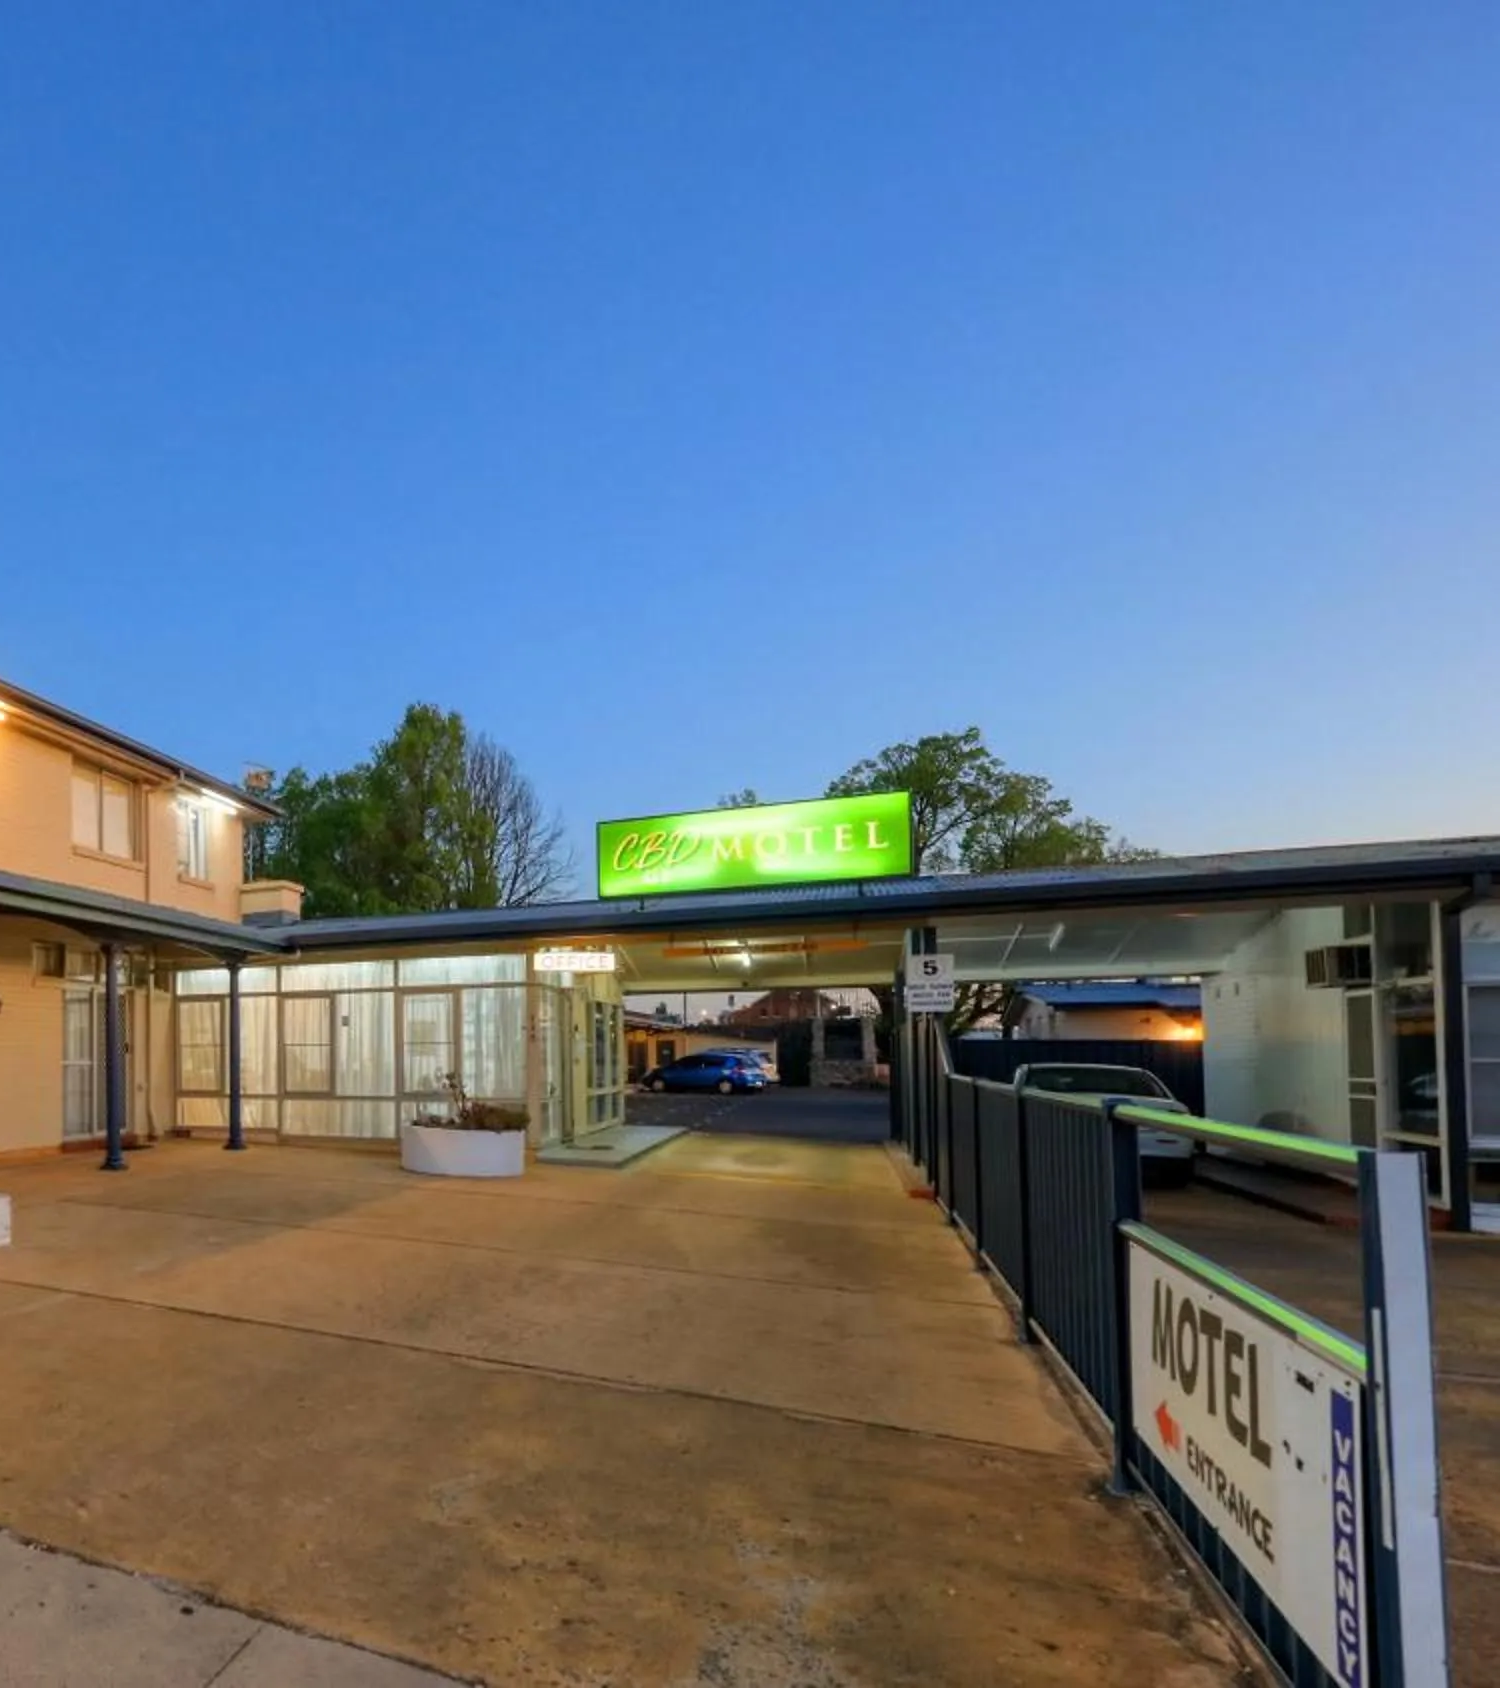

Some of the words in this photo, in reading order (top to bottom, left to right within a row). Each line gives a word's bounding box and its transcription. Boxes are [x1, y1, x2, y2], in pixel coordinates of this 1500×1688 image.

[612, 831, 701, 872] CBD
[711, 820, 889, 862] MOTEL
[542, 955, 609, 969] OFFICE
[923, 960, 938, 976] 5
[1151, 1278, 1272, 1470] MOTEL
[1186, 1436, 1275, 1565] ENTRANCE
[1334, 1429, 1358, 1682] VACANCY
